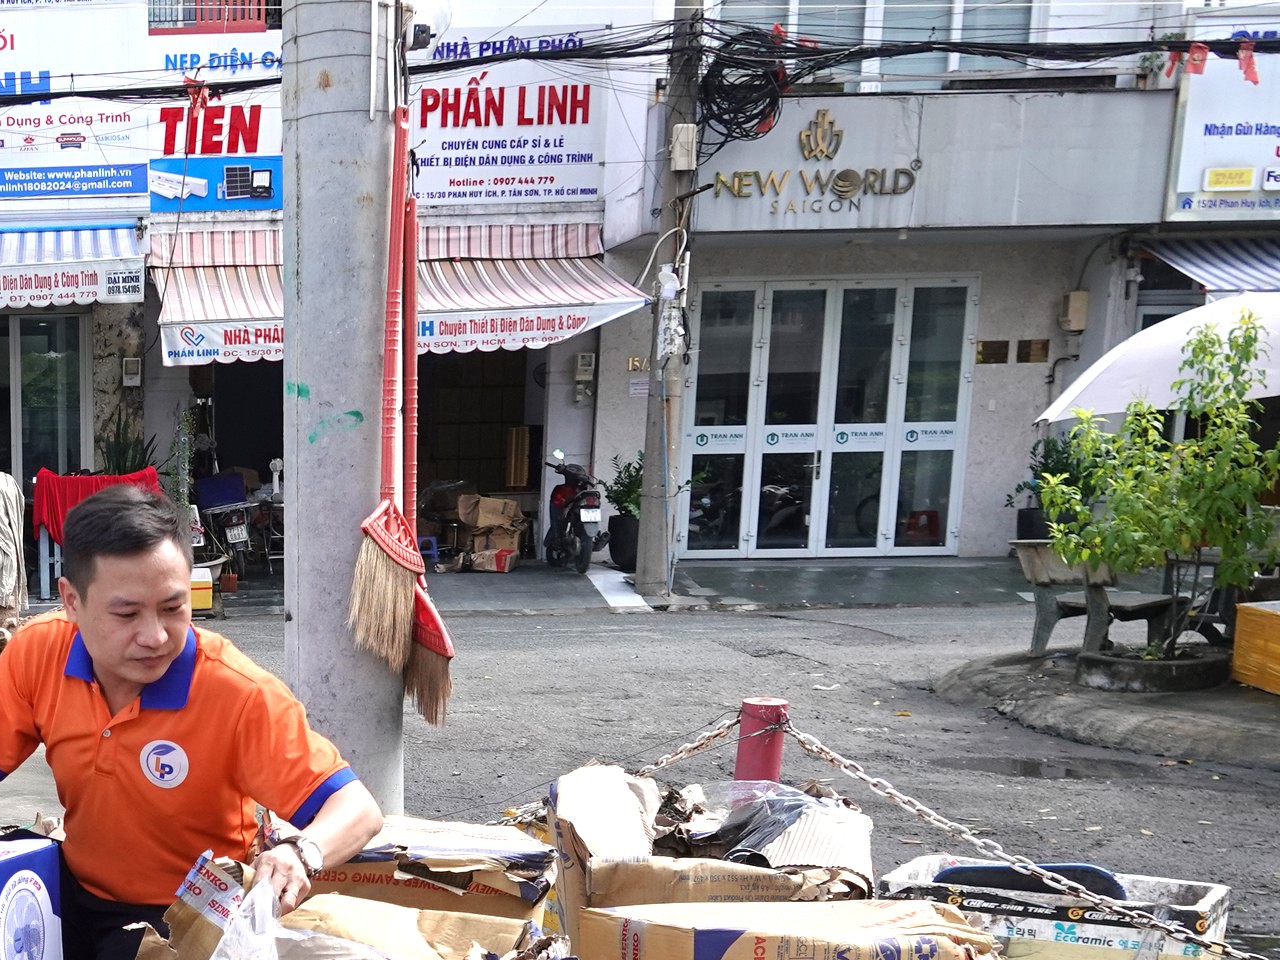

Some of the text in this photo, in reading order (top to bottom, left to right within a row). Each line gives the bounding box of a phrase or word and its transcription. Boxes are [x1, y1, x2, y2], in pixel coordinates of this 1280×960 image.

[432, 36, 470, 60] NHÀ
[165, 52, 201, 75] NẸP
[209, 47, 253, 74] ĐIỆN
[420, 71, 591, 128] PHẤN LINH
[6, 116, 41, 128] Dụng
[45, 115, 54, 125] &
[58, 113, 93, 126] Công
[98, 111, 131, 123] Trình
[1203, 121, 1253, 139] Nhận Gửi
[441, 135, 551, 150] CHUYÊN CUNG CẤP &
[443, 150, 593, 168] BỊ ĐIỆN DÂN DỤNG & CÔNG TRÌNH
[5, 168, 132, 181] Website: www.phanlinh.vn
[449, 176, 555, 187] Hotline 0907 444 779
[714, 167, 916, 200] NEW WORLD
[426, 187, 598, 199] 15/30 PHAN HUY TÂN MINH
[770, 198, 862, 215] SAIGON
[1197, 197, 1256, 210] 15/24 Phan Huy
[2, 274, 18, 295] Điện
[20, 273, 32, 290] Dân
[34, 273, 52, 293] Dụng
[54, 273, 60, 289] &
[61, 270, 79, 291] Công
[80, 269, 98, 288] Trình
[121, 273, 140, 284] MINH
[29, 293, 54, 301] 0907
[79, 290, 97, 298] 779
[438, 319, 467, 337] Chuyên
[469, 315, 489, 335] Thiết
[490, 318, 498, 337] Bị
[500, 317, 518, 336] Điện
[519, 316, 535, 332] Dân
[536, 316, 556, 335] Dụng
[558, 315, 564, 330] &
[223, 325, 251, 345] NHÀ
[481, 338, 506, 346] HCM
[167, 346, 220, 358] PHẤN LINH
[351, 872, 401, 886] SAVING
[1055, 931, 1114, 948] Ecoramic
